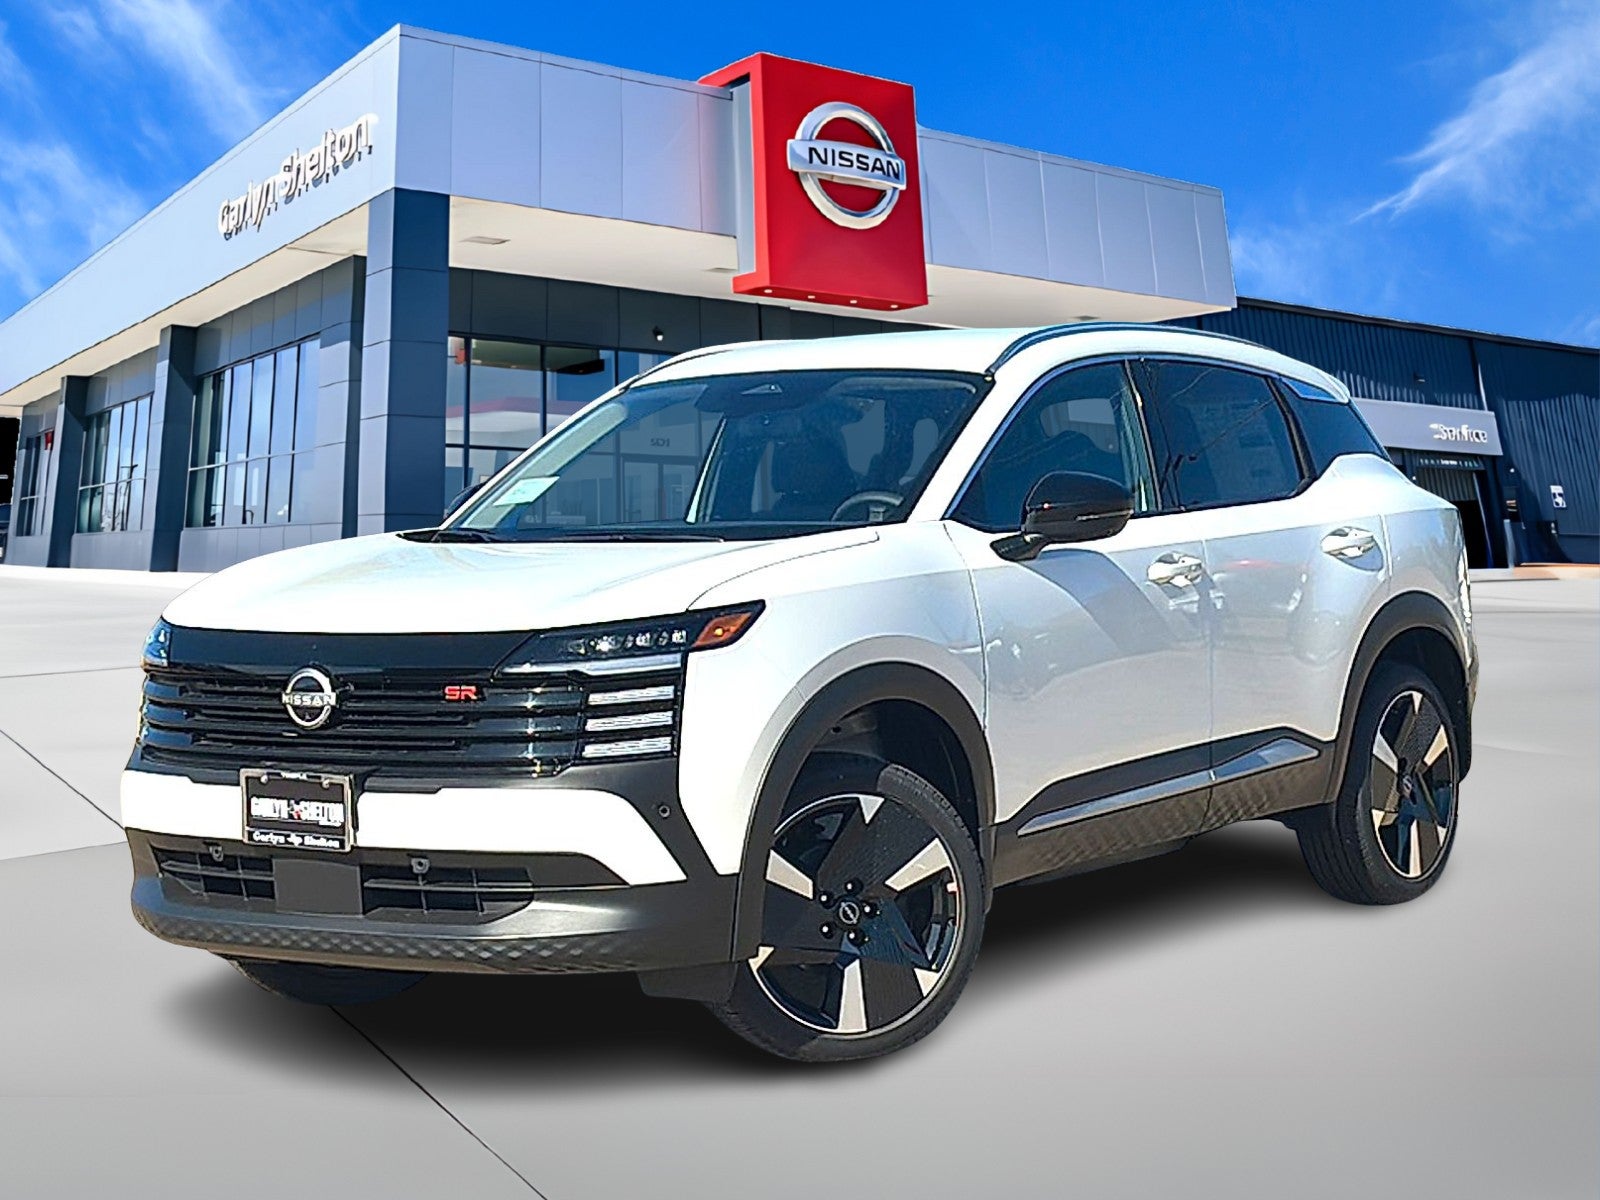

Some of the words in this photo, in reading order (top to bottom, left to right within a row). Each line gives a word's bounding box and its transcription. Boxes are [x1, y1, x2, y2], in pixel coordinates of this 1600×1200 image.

[280, 116, 373, 204] Shelton
[807, 146, 900, 180] NISSAN
[1429, 423, 1487, 443] Service
[282, 692, 336, 707] NISSAN
[444, 685, 478, 700] SR
